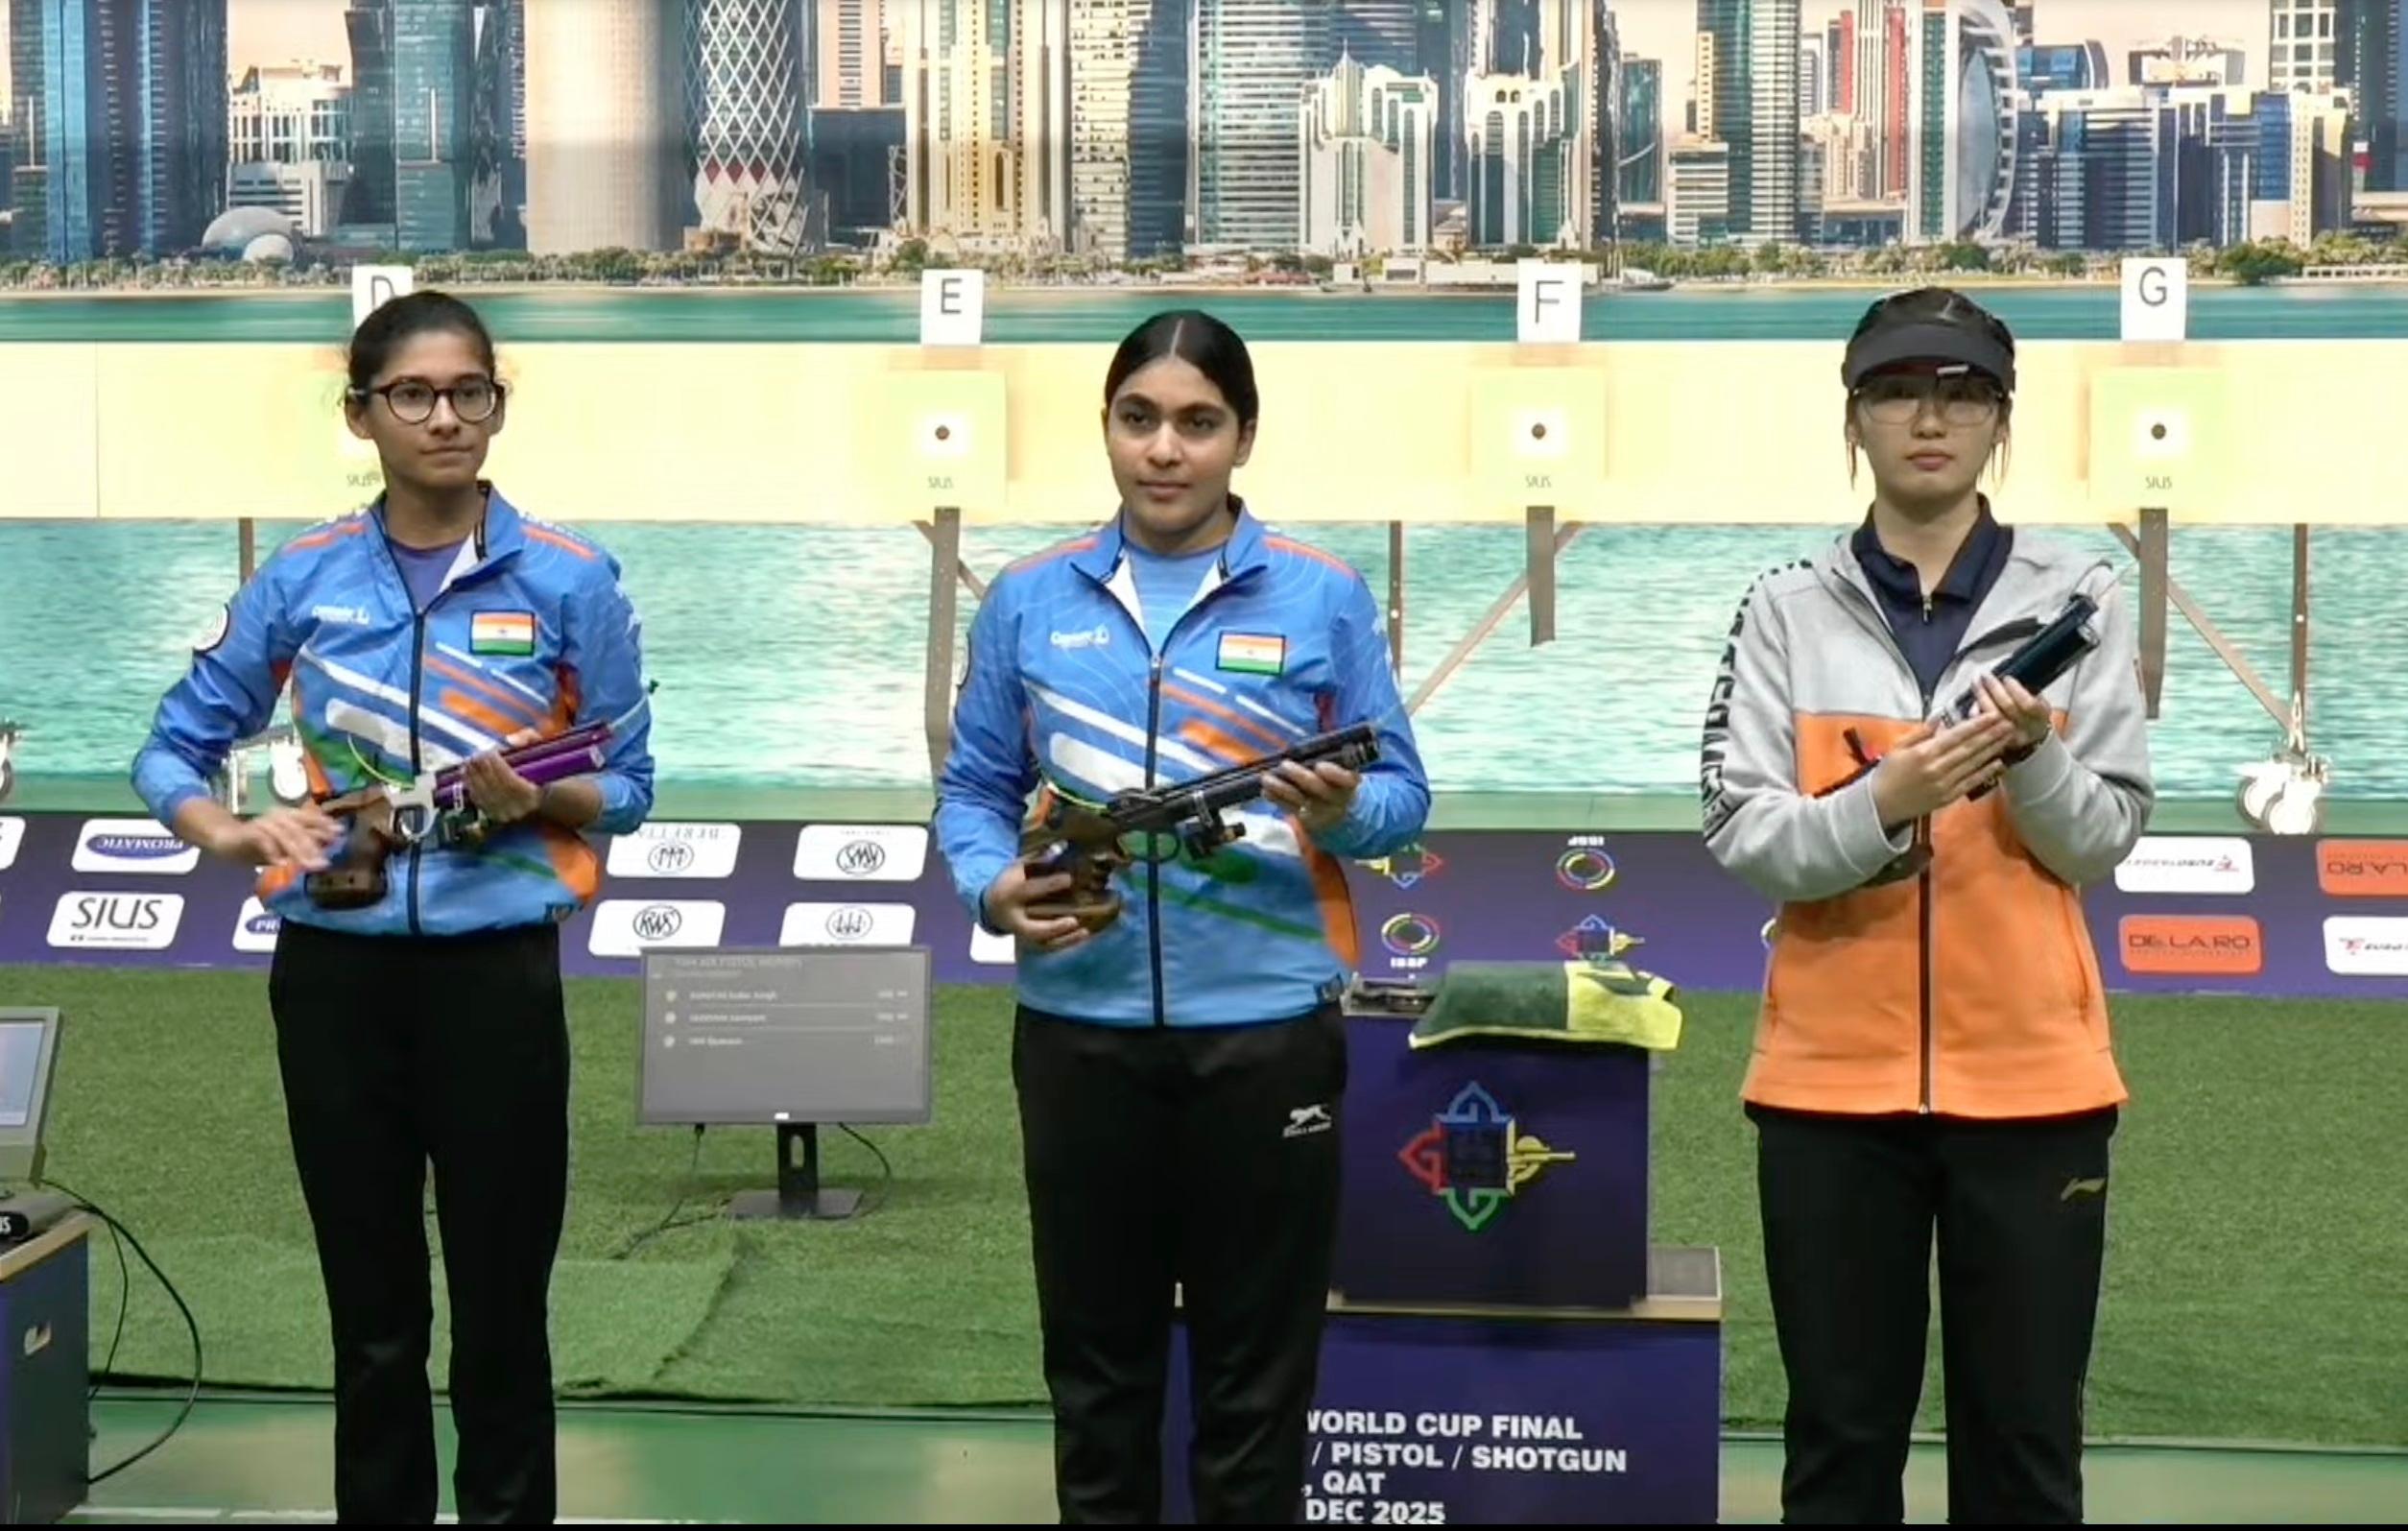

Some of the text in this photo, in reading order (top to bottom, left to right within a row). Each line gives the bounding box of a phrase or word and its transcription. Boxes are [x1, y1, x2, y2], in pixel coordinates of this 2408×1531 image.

[941, 278, 962, 314] E
[1535, 280, 1563, 323] F
[2139, 266, 2167, 306] G
[71, 897, 163, 930] SIUS
[1416, 1412, 1483, 1438] CUP
[1491, 1415, 1583, 1440] FINAL
[1331, 1441, 1443, 1468] PISTOL
[1451, 1444, 1464, 1471] /
[1471, 1446, 1627, 1471] SHOTGUN
[1323, 1470, 1386, 1495] QAT
[1305, 1498, 1445, 1524] DEC 2025
